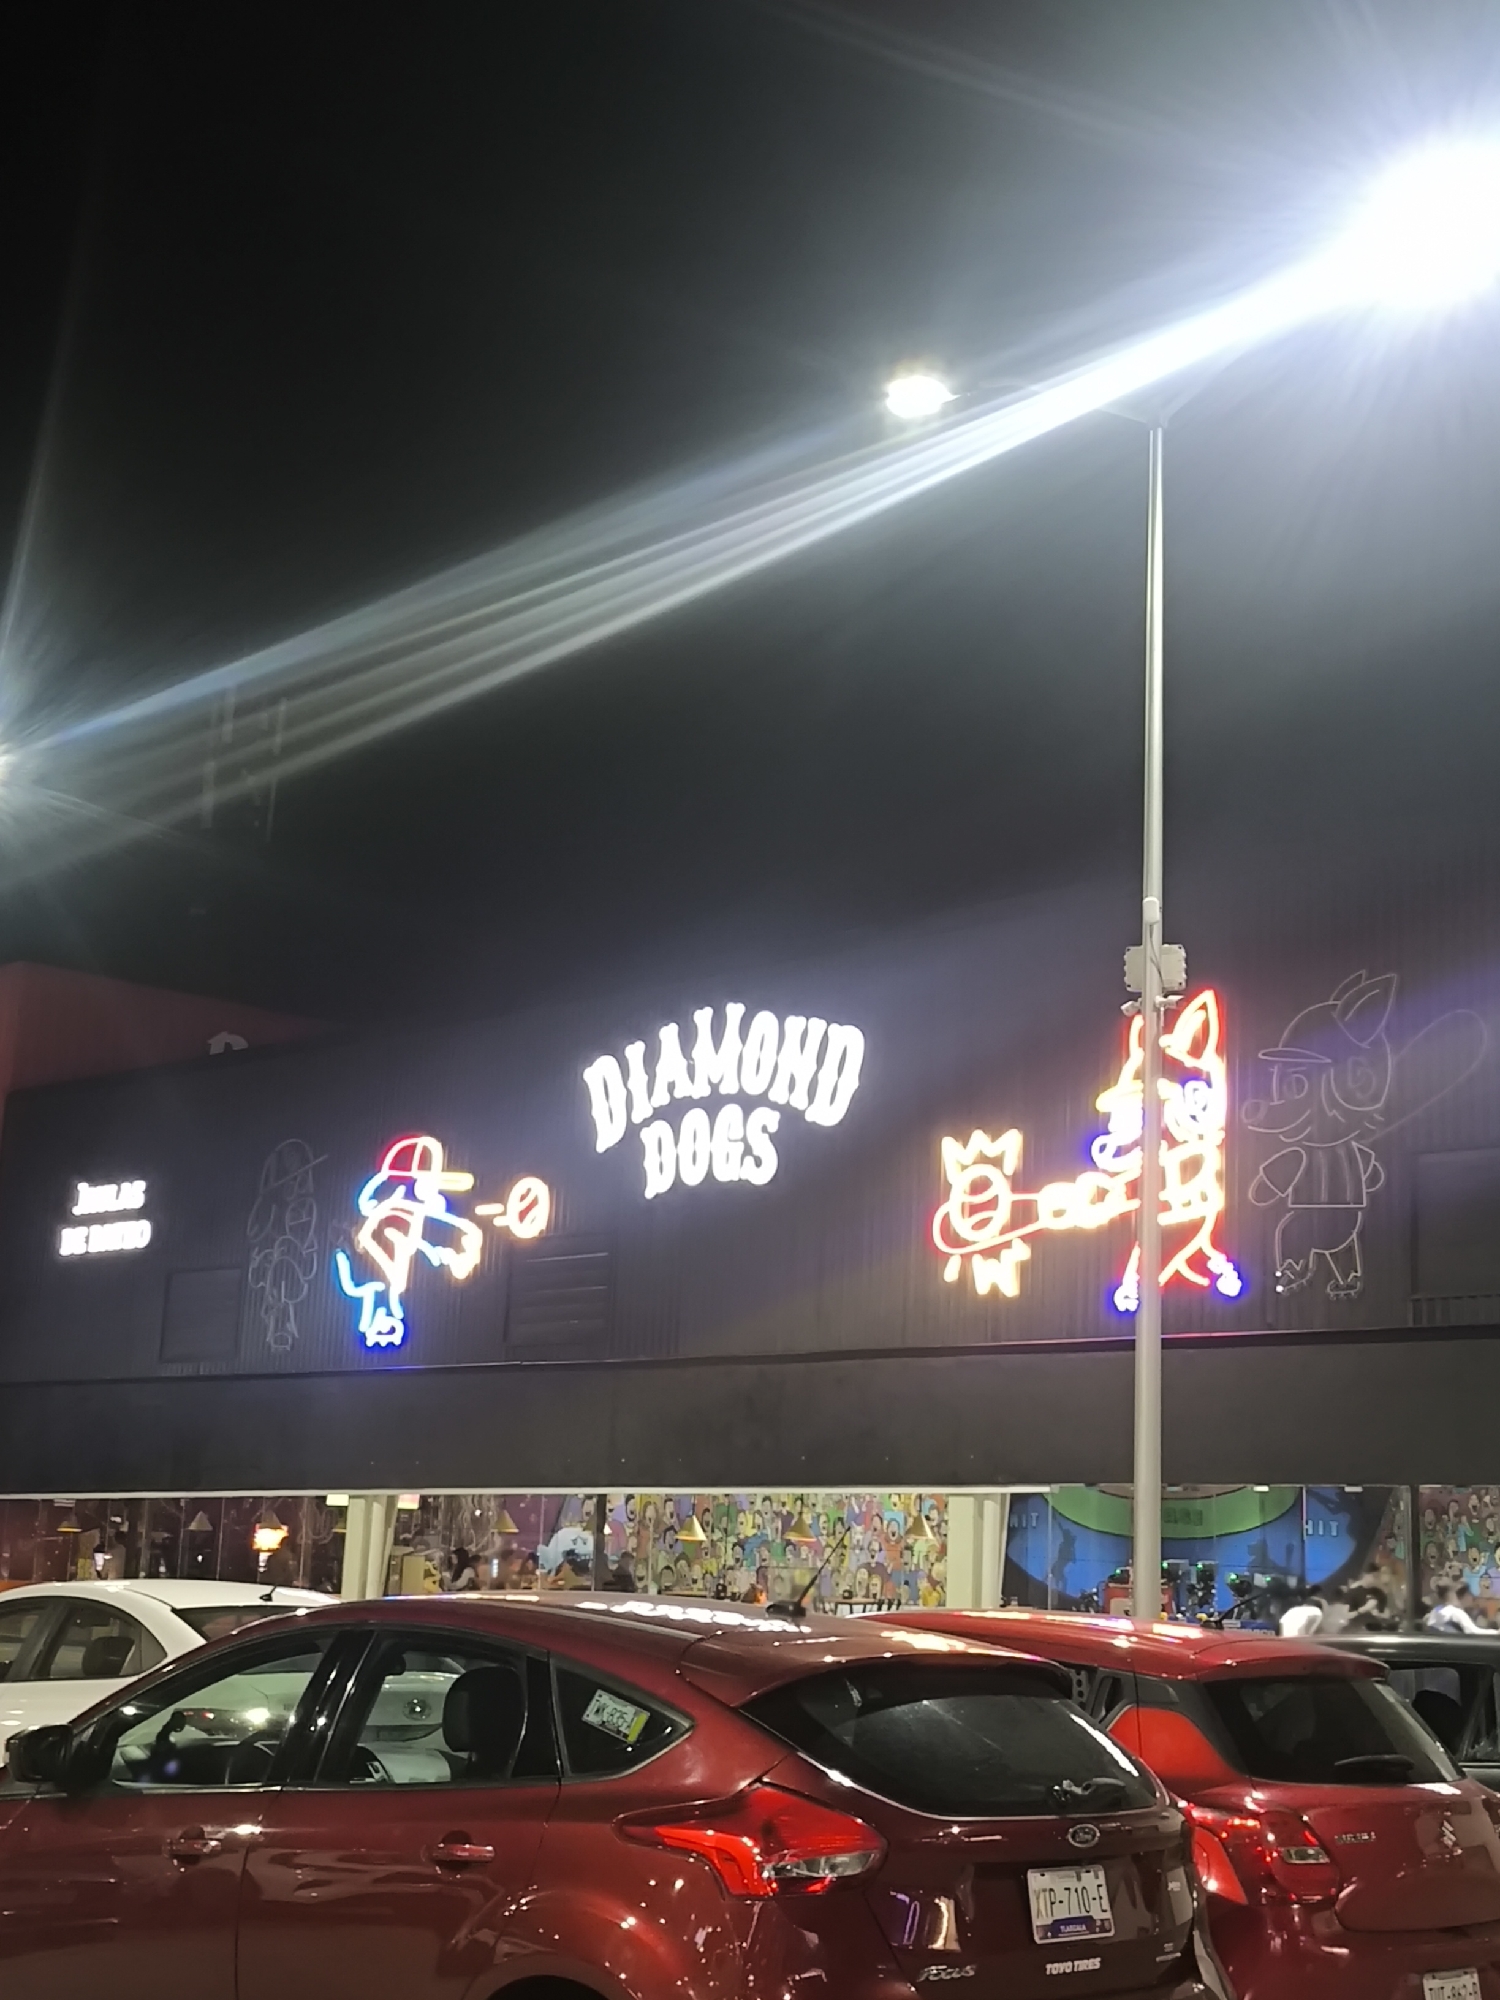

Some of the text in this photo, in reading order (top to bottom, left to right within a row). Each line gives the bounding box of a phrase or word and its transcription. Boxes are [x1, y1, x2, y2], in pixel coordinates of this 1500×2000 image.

[582, 1001, 865, 1153] DIAMOND
[640, 1103, 781, 1199] DOGS
[1033, 1884, 1107, 1919] XTP-710-E
[1045, 1957, 1101, 1975] TOYO TIRES
